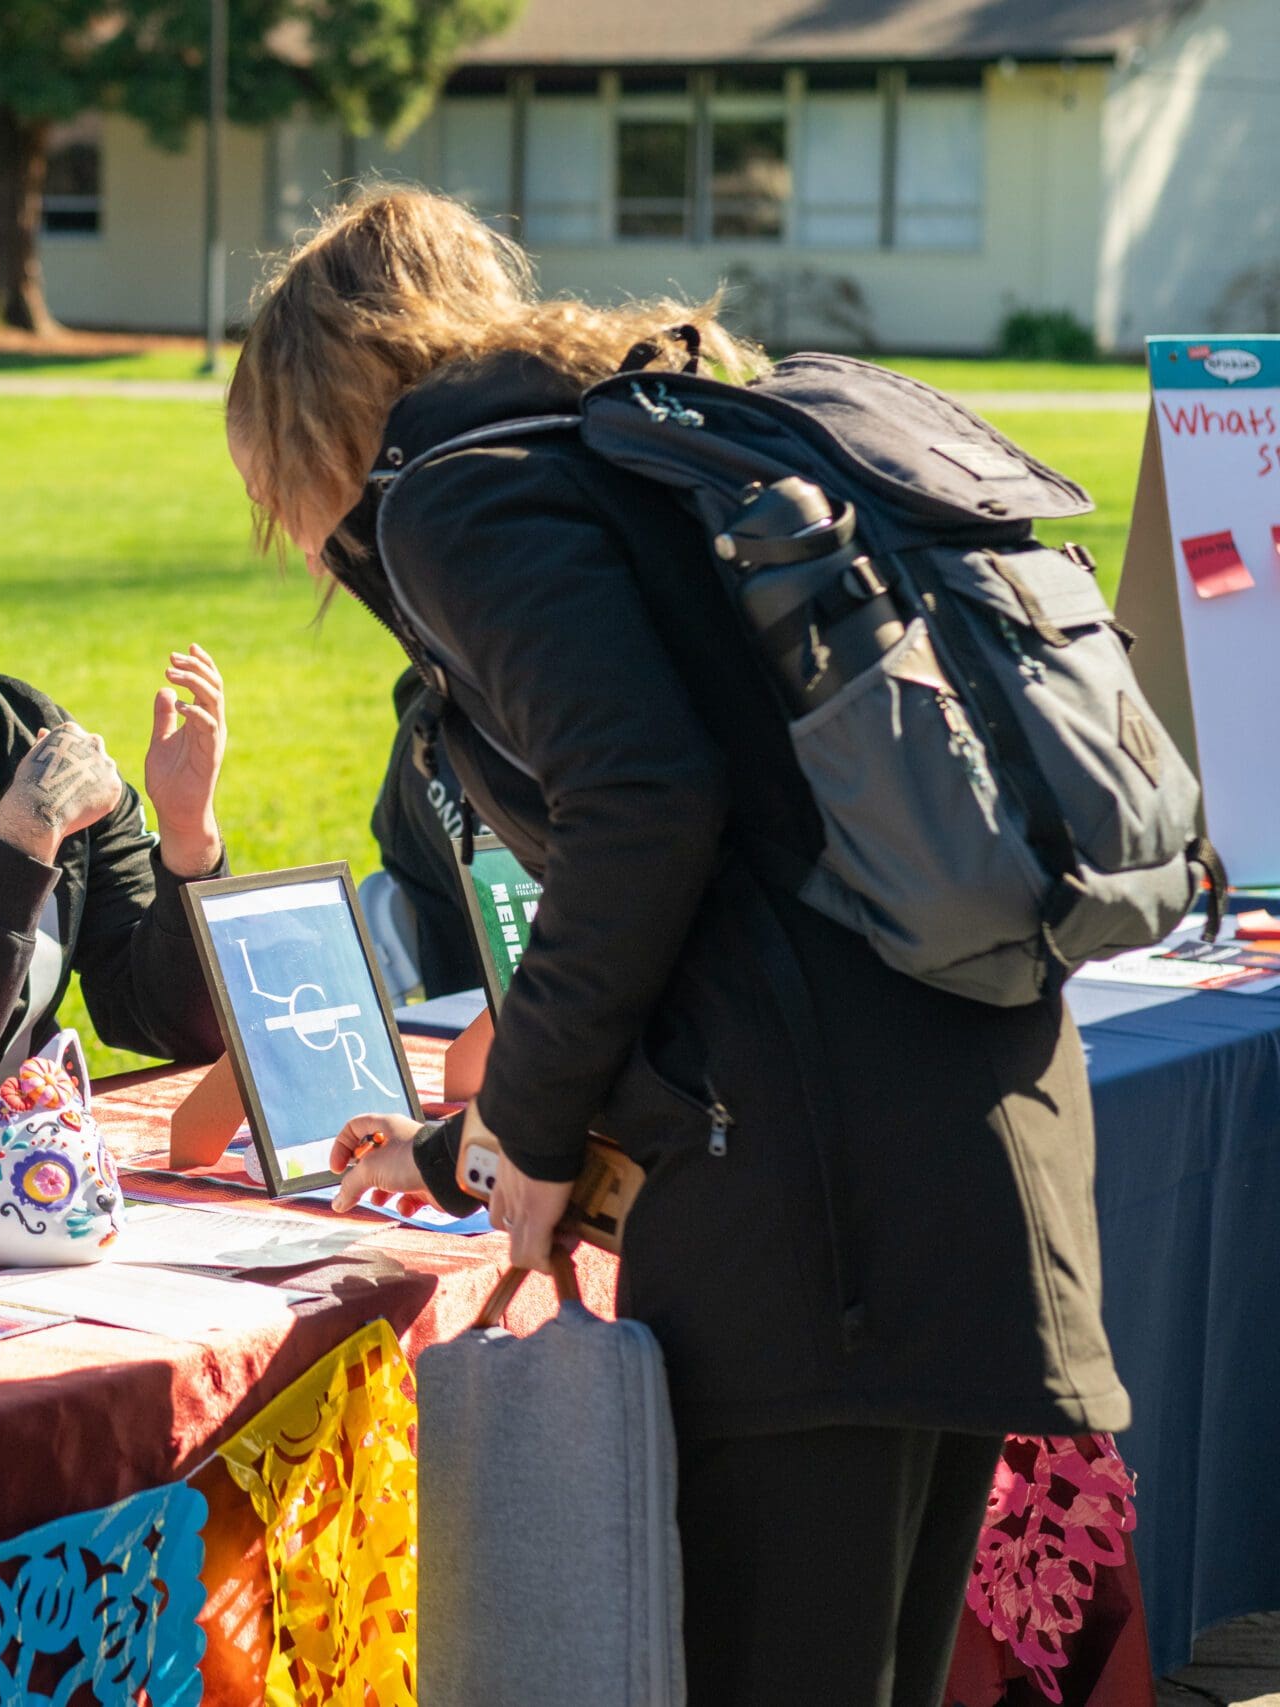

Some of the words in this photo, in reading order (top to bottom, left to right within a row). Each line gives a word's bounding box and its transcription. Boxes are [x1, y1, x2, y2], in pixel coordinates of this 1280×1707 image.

[1160, 400, 1276, 437] Whats
[1258, 444, 1280, 477] S
[490, 883, 524, 974] MENL
